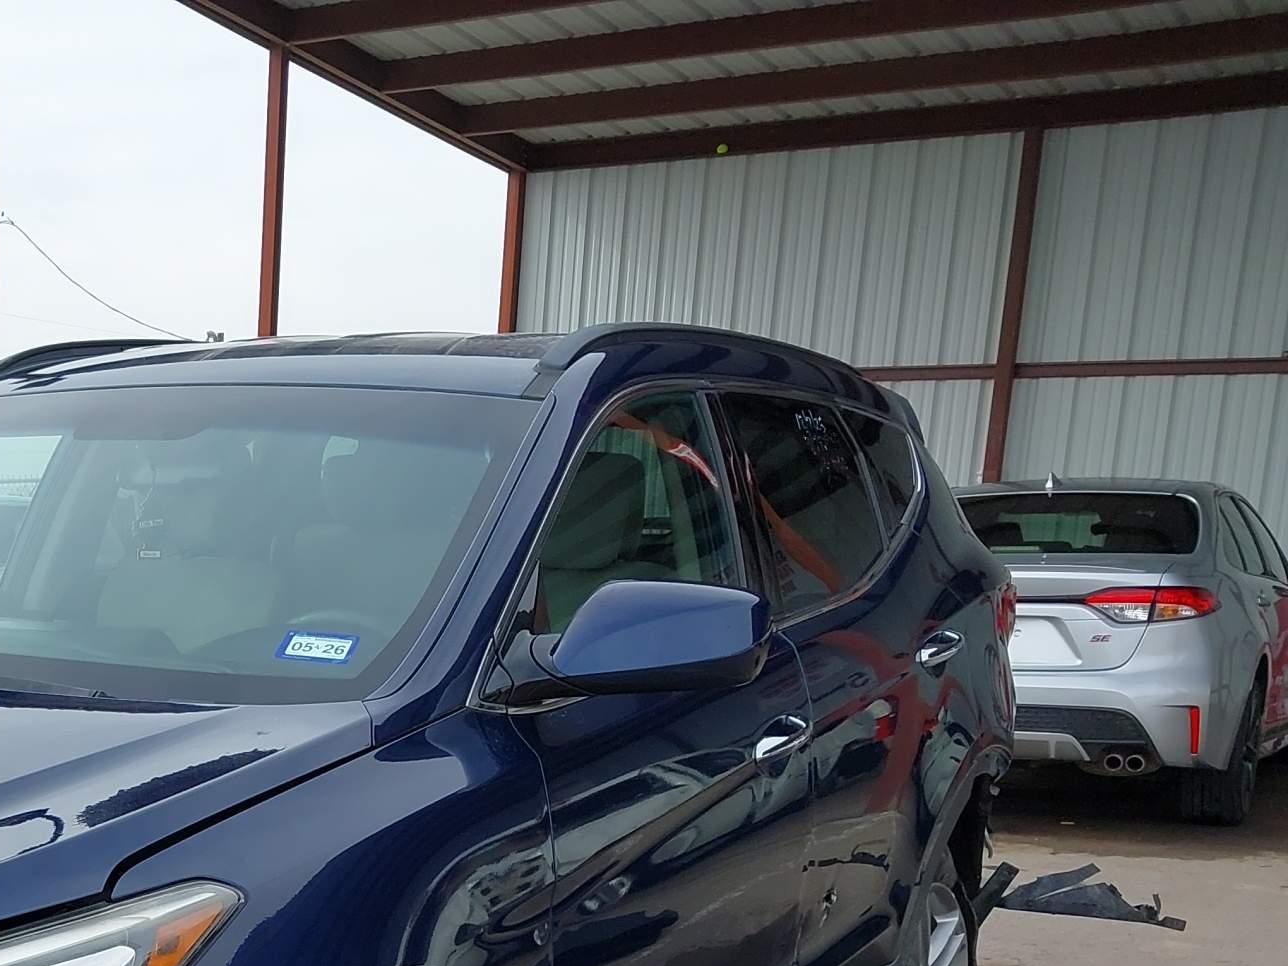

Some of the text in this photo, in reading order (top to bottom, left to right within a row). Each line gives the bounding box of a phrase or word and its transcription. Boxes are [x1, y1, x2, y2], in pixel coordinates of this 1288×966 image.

[1089, 634, 1112, 643] SE
[291, 641, 347, 656] 05 26
